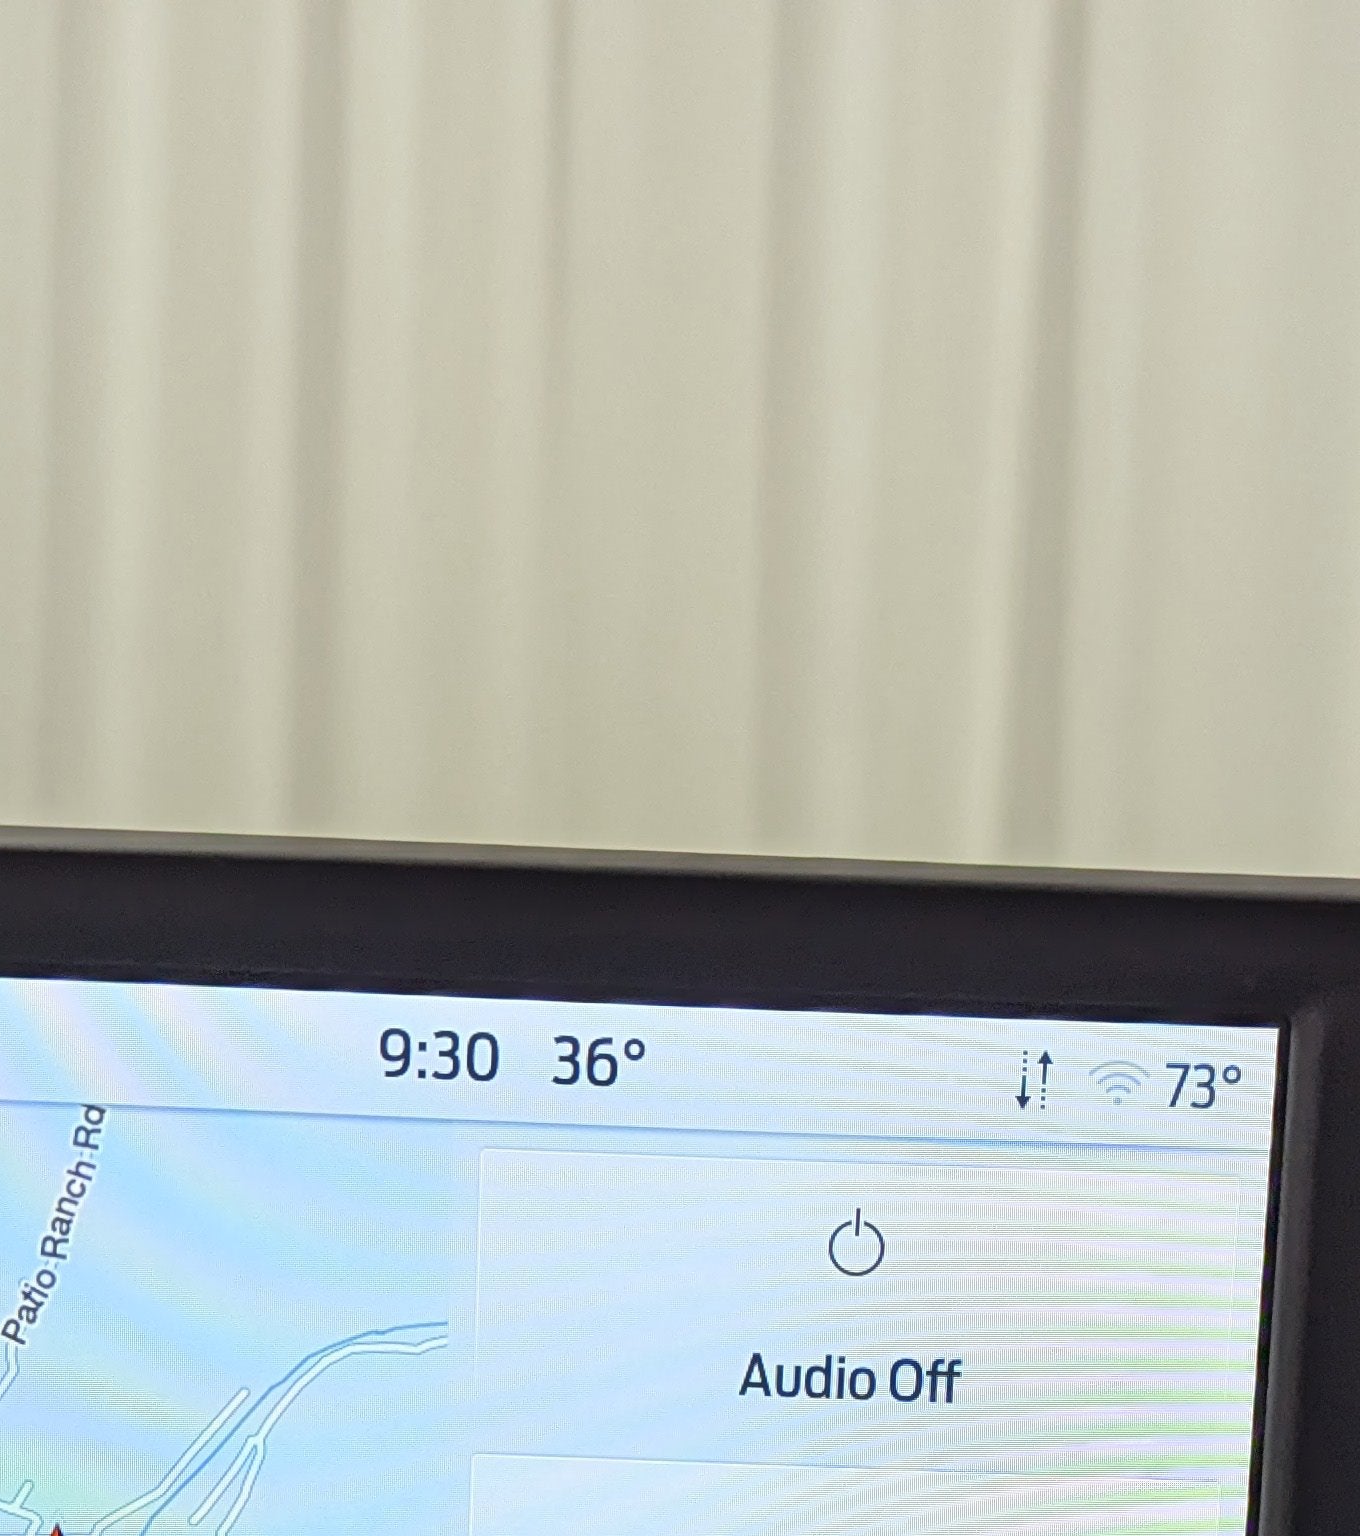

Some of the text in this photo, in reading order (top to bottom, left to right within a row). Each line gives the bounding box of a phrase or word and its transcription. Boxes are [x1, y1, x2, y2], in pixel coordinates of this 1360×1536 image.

[379, 1027, 499, 1083] 9:30
[552, 1035, 646, 1086] 36°
[1164, 1061, 1242, 1109] 73°
[1, 1104, 108, 1346] Patio Ranch Rd
[739, 1352, 962, 1403] Audio Off
